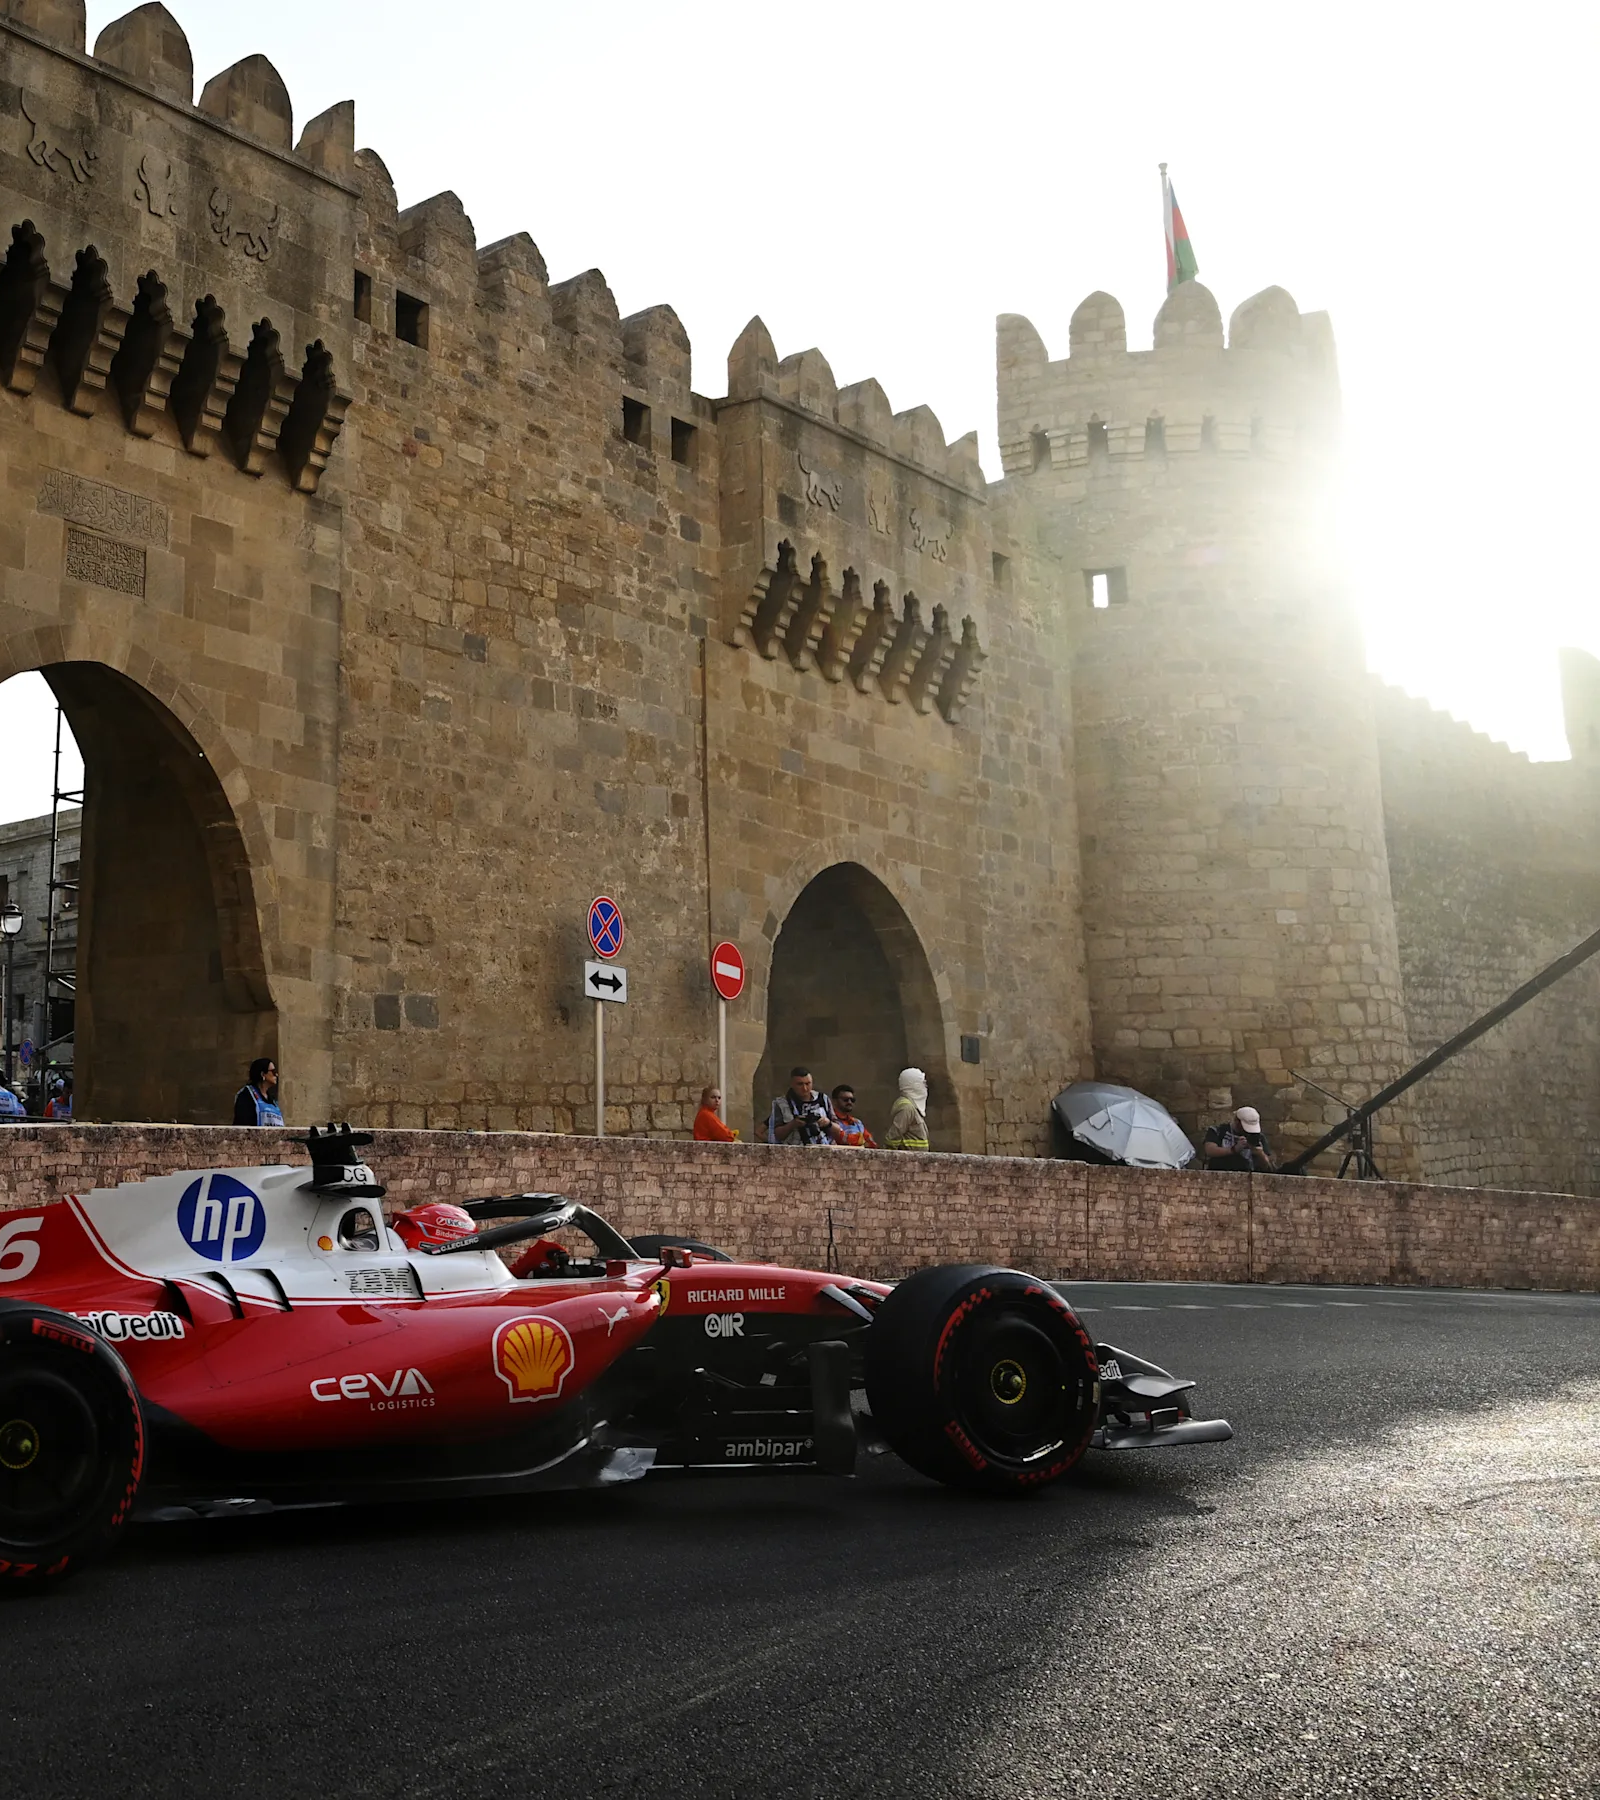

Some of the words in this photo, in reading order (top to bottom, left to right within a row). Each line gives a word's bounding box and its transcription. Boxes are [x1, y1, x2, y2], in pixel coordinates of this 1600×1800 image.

[190, 1174, 256, 1261] hp
[440, 1237, 479, 1252] C.LECLERC
[344, 1268, 413, 1293] IBM
[687, 1288, 744, 1303] RICHARD
[748, 1287, 785, 1300] MILLE
[80, 1312, 182, 1338] iCredit
[1098, 1360, 1122, 1378] edit
[369, 1397, 436, 1412] LOGISTICS
[725, 1439, 804, 1459] ambipar
